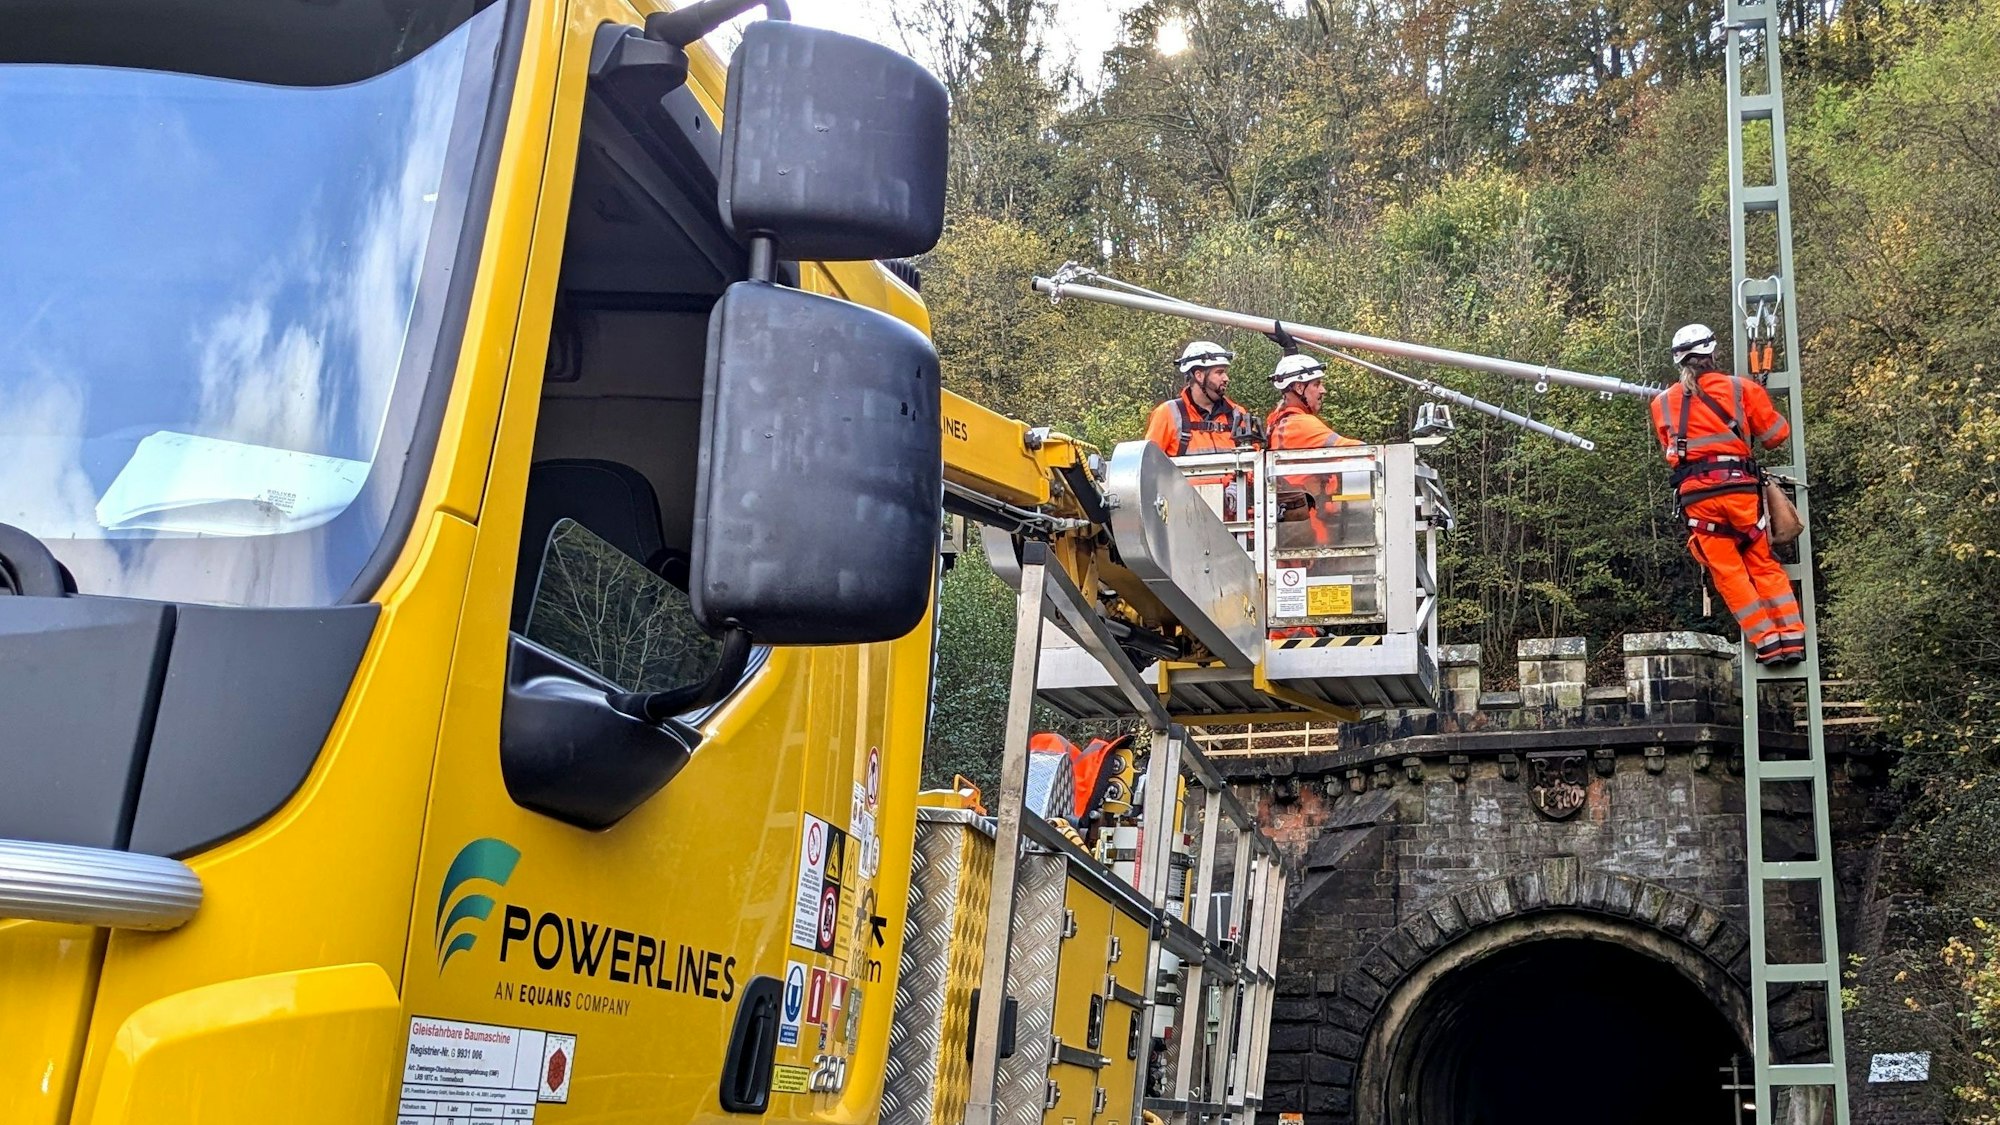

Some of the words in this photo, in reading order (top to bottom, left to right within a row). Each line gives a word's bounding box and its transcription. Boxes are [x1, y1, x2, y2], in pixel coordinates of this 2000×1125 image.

[942, 415, 968, 442] INES
[500, 904, 737, 1003] POWERLINES
[495, 981, 515, 1000] AN
[519, 984, 572, 1009] EQUANS
[576, 992, 632, 1017] COMPANY
[412, 1022, 463, 1039] Gleisfahrbare
[464, 1028, 511, 1044] Baumaschine
[410, 1044, 449, 1057] Registrier-Nr.
